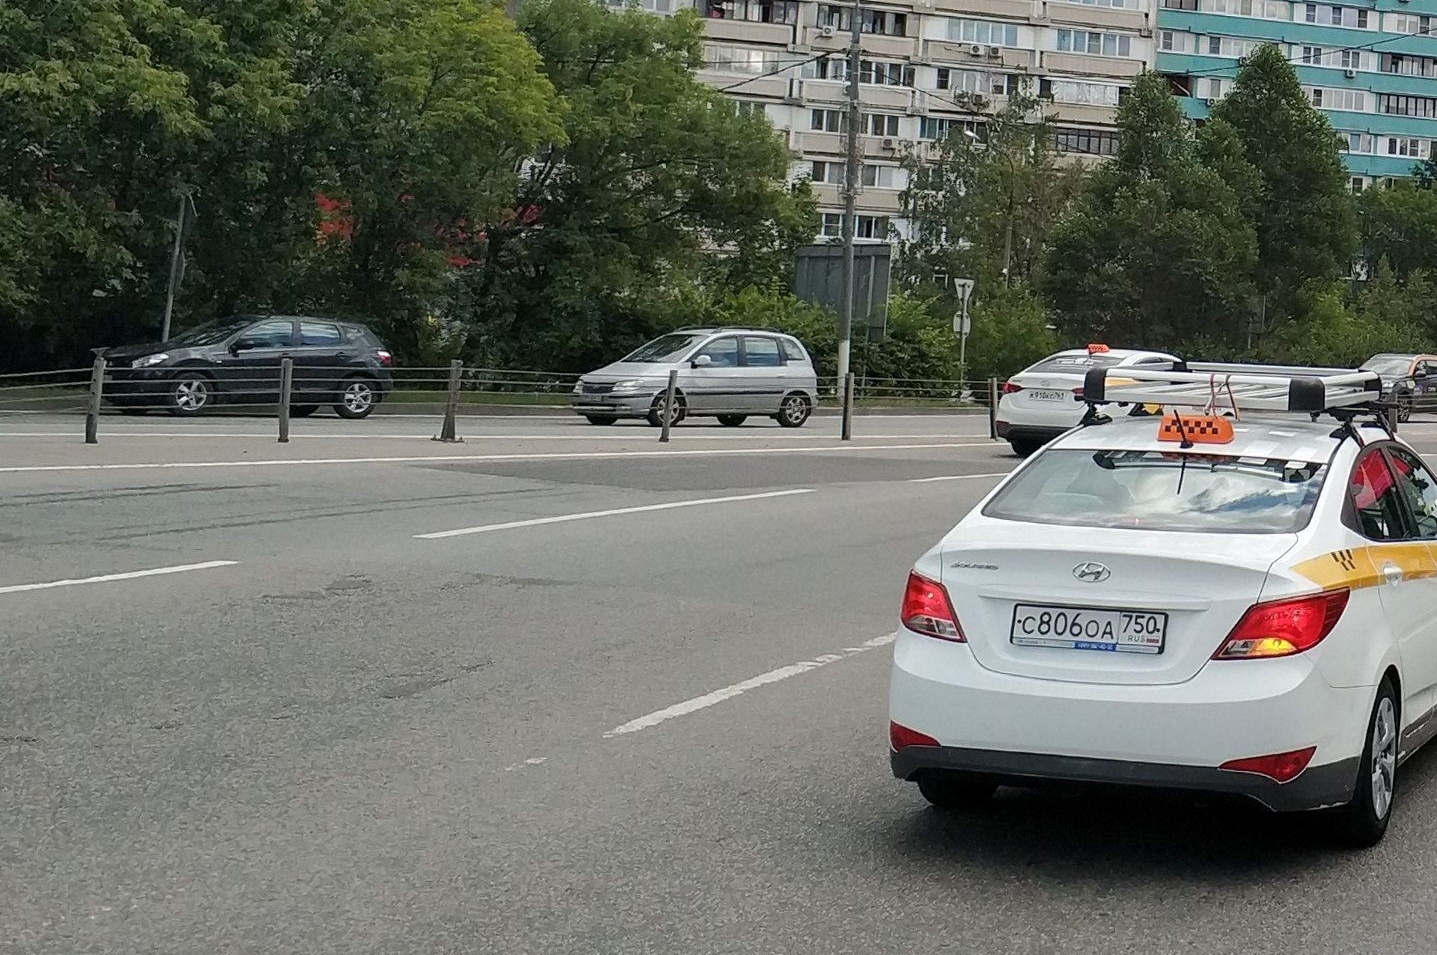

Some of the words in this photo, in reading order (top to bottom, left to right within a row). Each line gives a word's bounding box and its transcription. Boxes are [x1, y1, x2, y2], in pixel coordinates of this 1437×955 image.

[1022, 611, 1114, 640] С806ОА
[1122, 614, 1158, 635] 750
[1127, 635, 1146, 643] RUS
